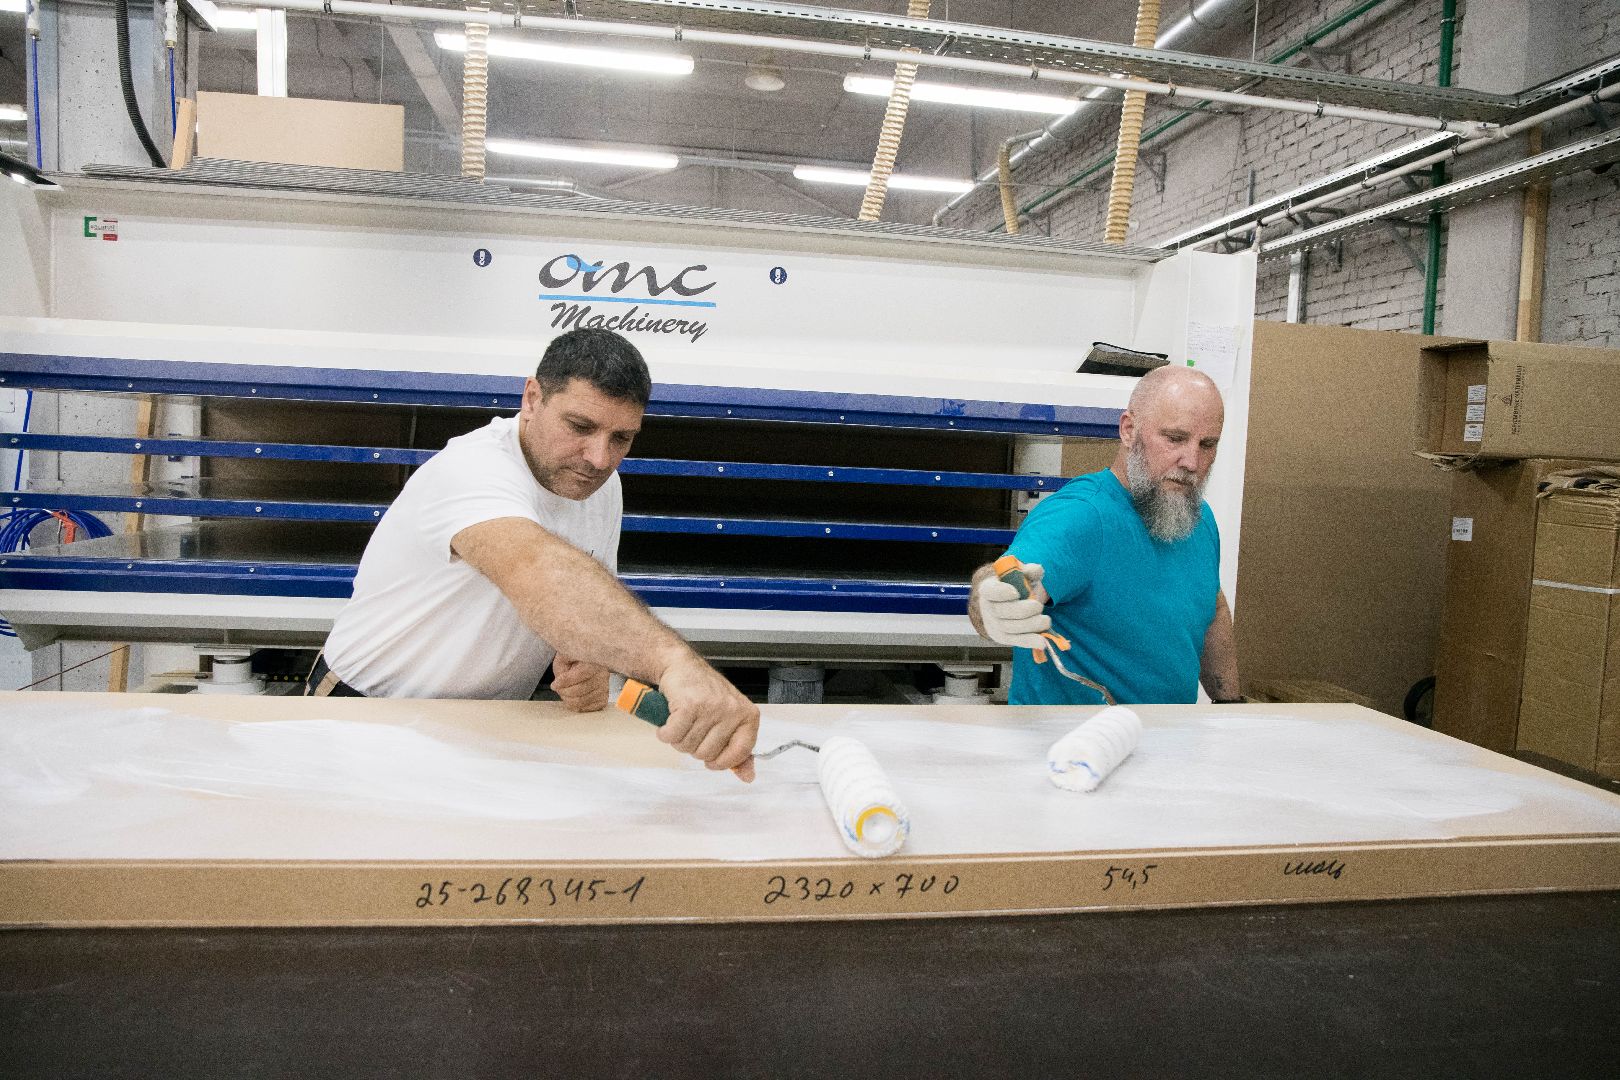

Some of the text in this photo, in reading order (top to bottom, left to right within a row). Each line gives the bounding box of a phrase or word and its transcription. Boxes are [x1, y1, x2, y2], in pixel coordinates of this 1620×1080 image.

[550, 302, 709, 344] Machinery
[415, 876, 646, 908] 25-268345-1
[763, 875, 854, 904] 2320
[895, 873, 960, 899] 700
